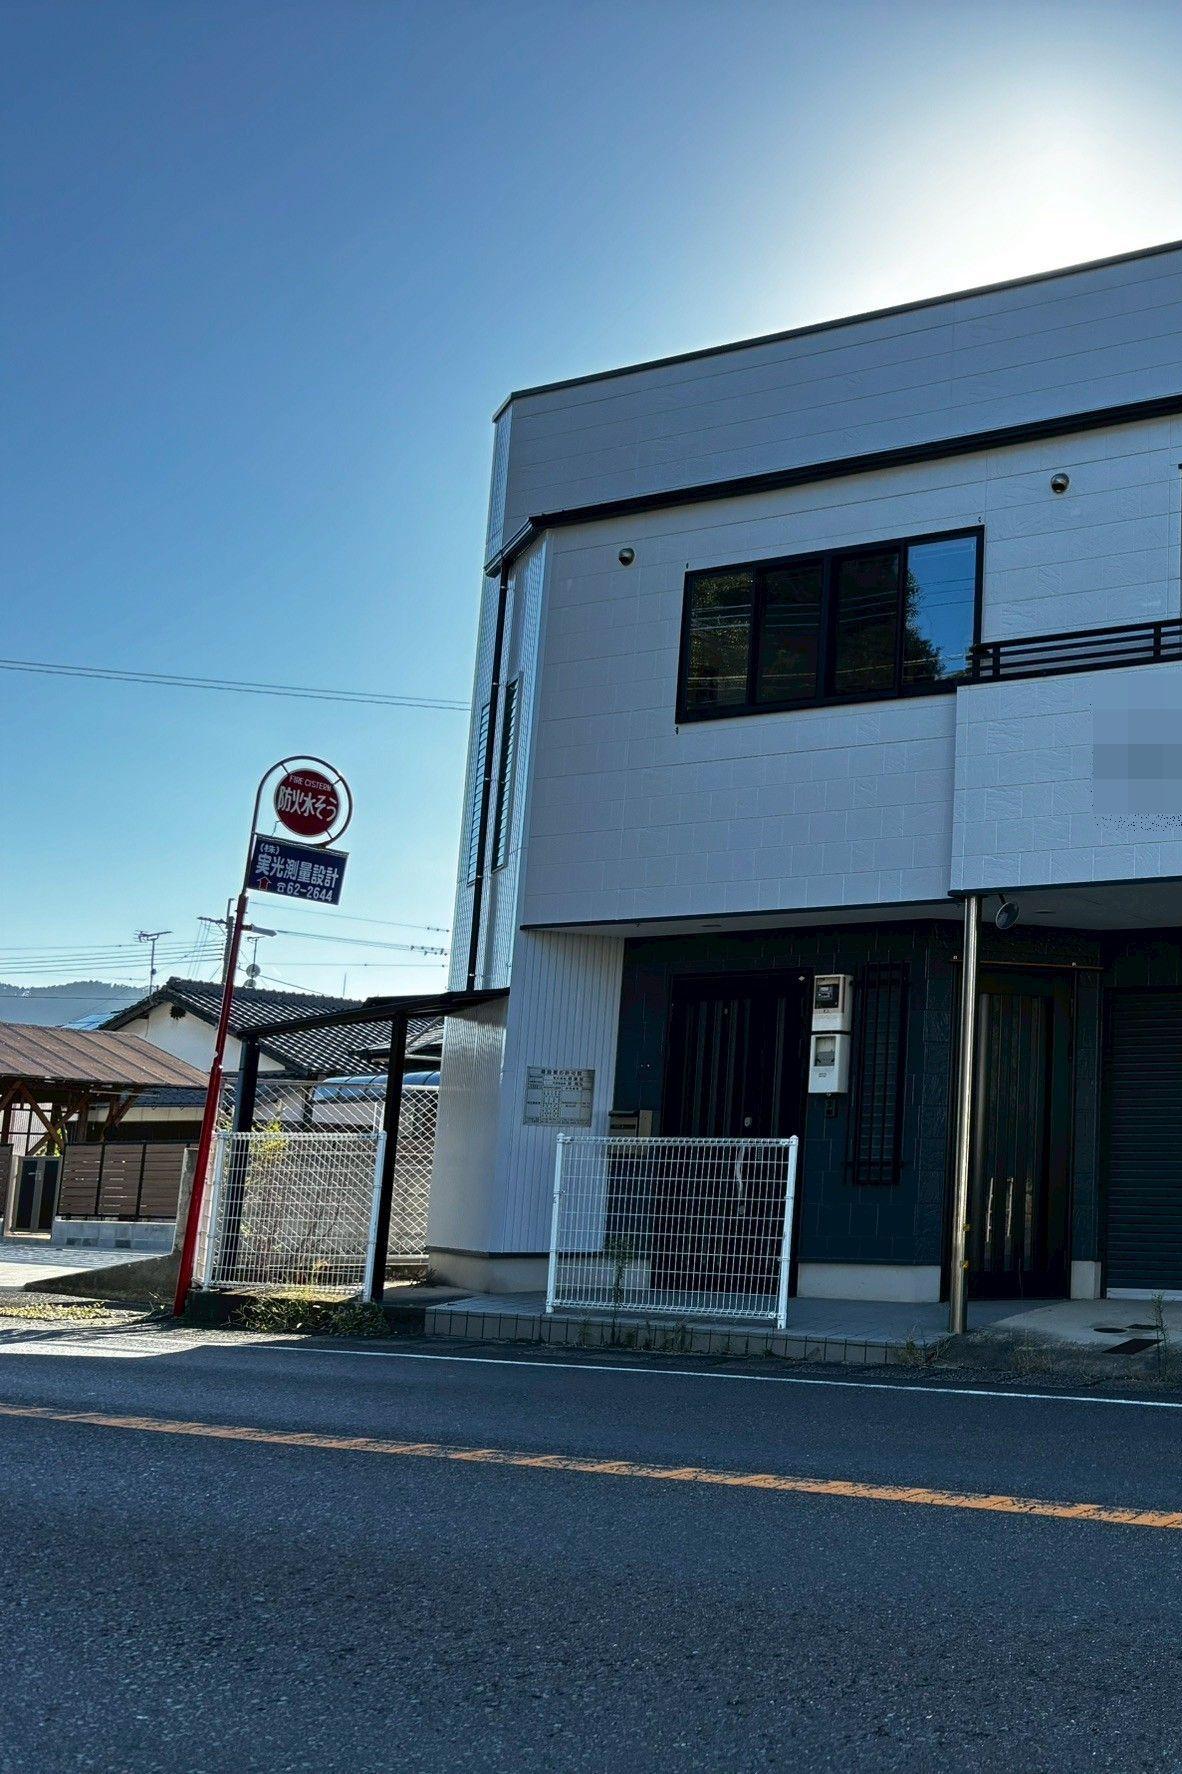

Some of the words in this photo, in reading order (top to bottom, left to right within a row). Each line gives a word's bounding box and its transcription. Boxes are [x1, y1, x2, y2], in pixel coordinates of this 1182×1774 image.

[289, 775, 304, 785] FIRE
[304, 779, 332, 791] CISTERN
[278, 786, 337, 821] 防火水そう
